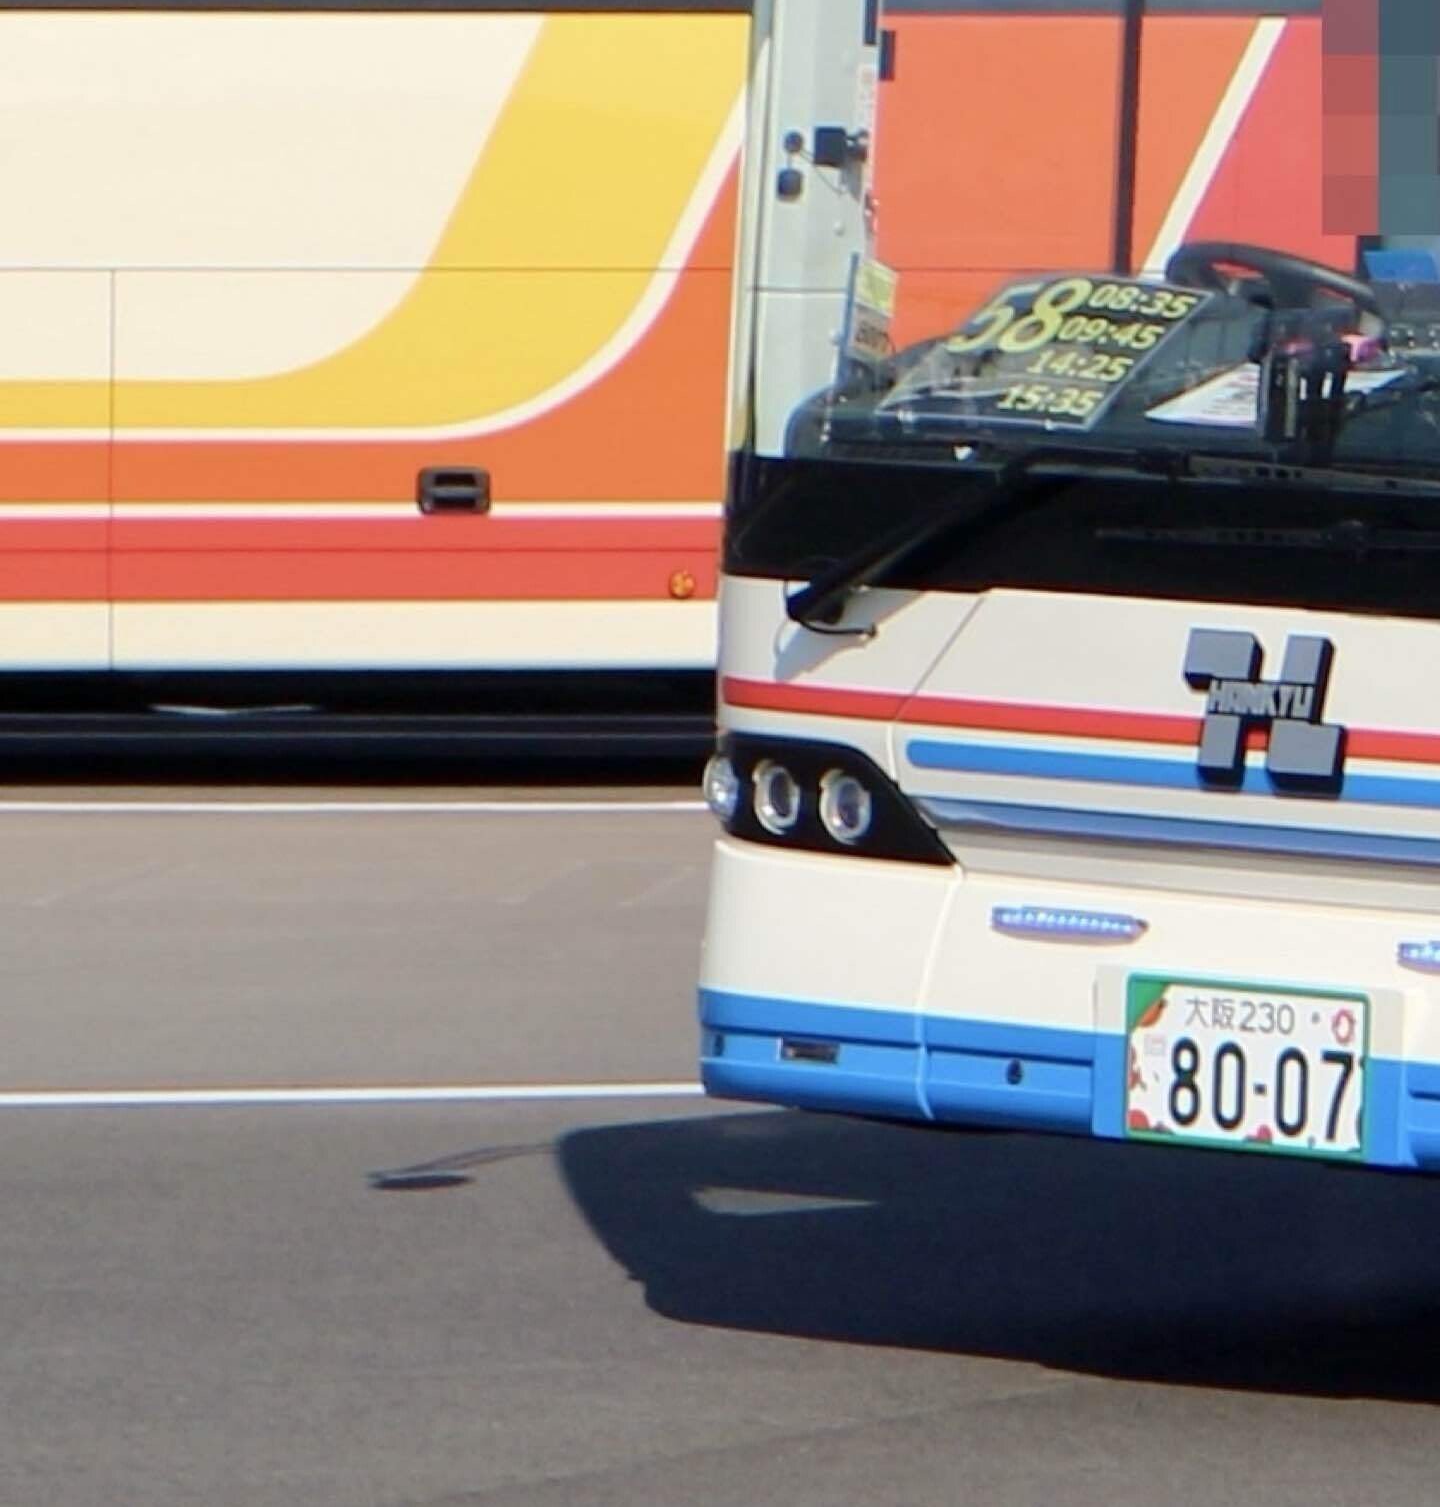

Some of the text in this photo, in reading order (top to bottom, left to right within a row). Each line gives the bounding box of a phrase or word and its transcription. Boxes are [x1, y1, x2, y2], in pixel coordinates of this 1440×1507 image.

[946, 278, 1093, 353] 58
[1090, 283, 1199, 319] 08:35
[1058, 316, 1167, 350] 09:45
[1026, 349, 1134, 383] 14:25
[997, 384, 1103, 417] 15:35
[1207, 678, 1316, 721] HANKYU
[1184, 996, 1296, 1036] 大阪230
[1168, 1036, 1355, 1142] 80-07
